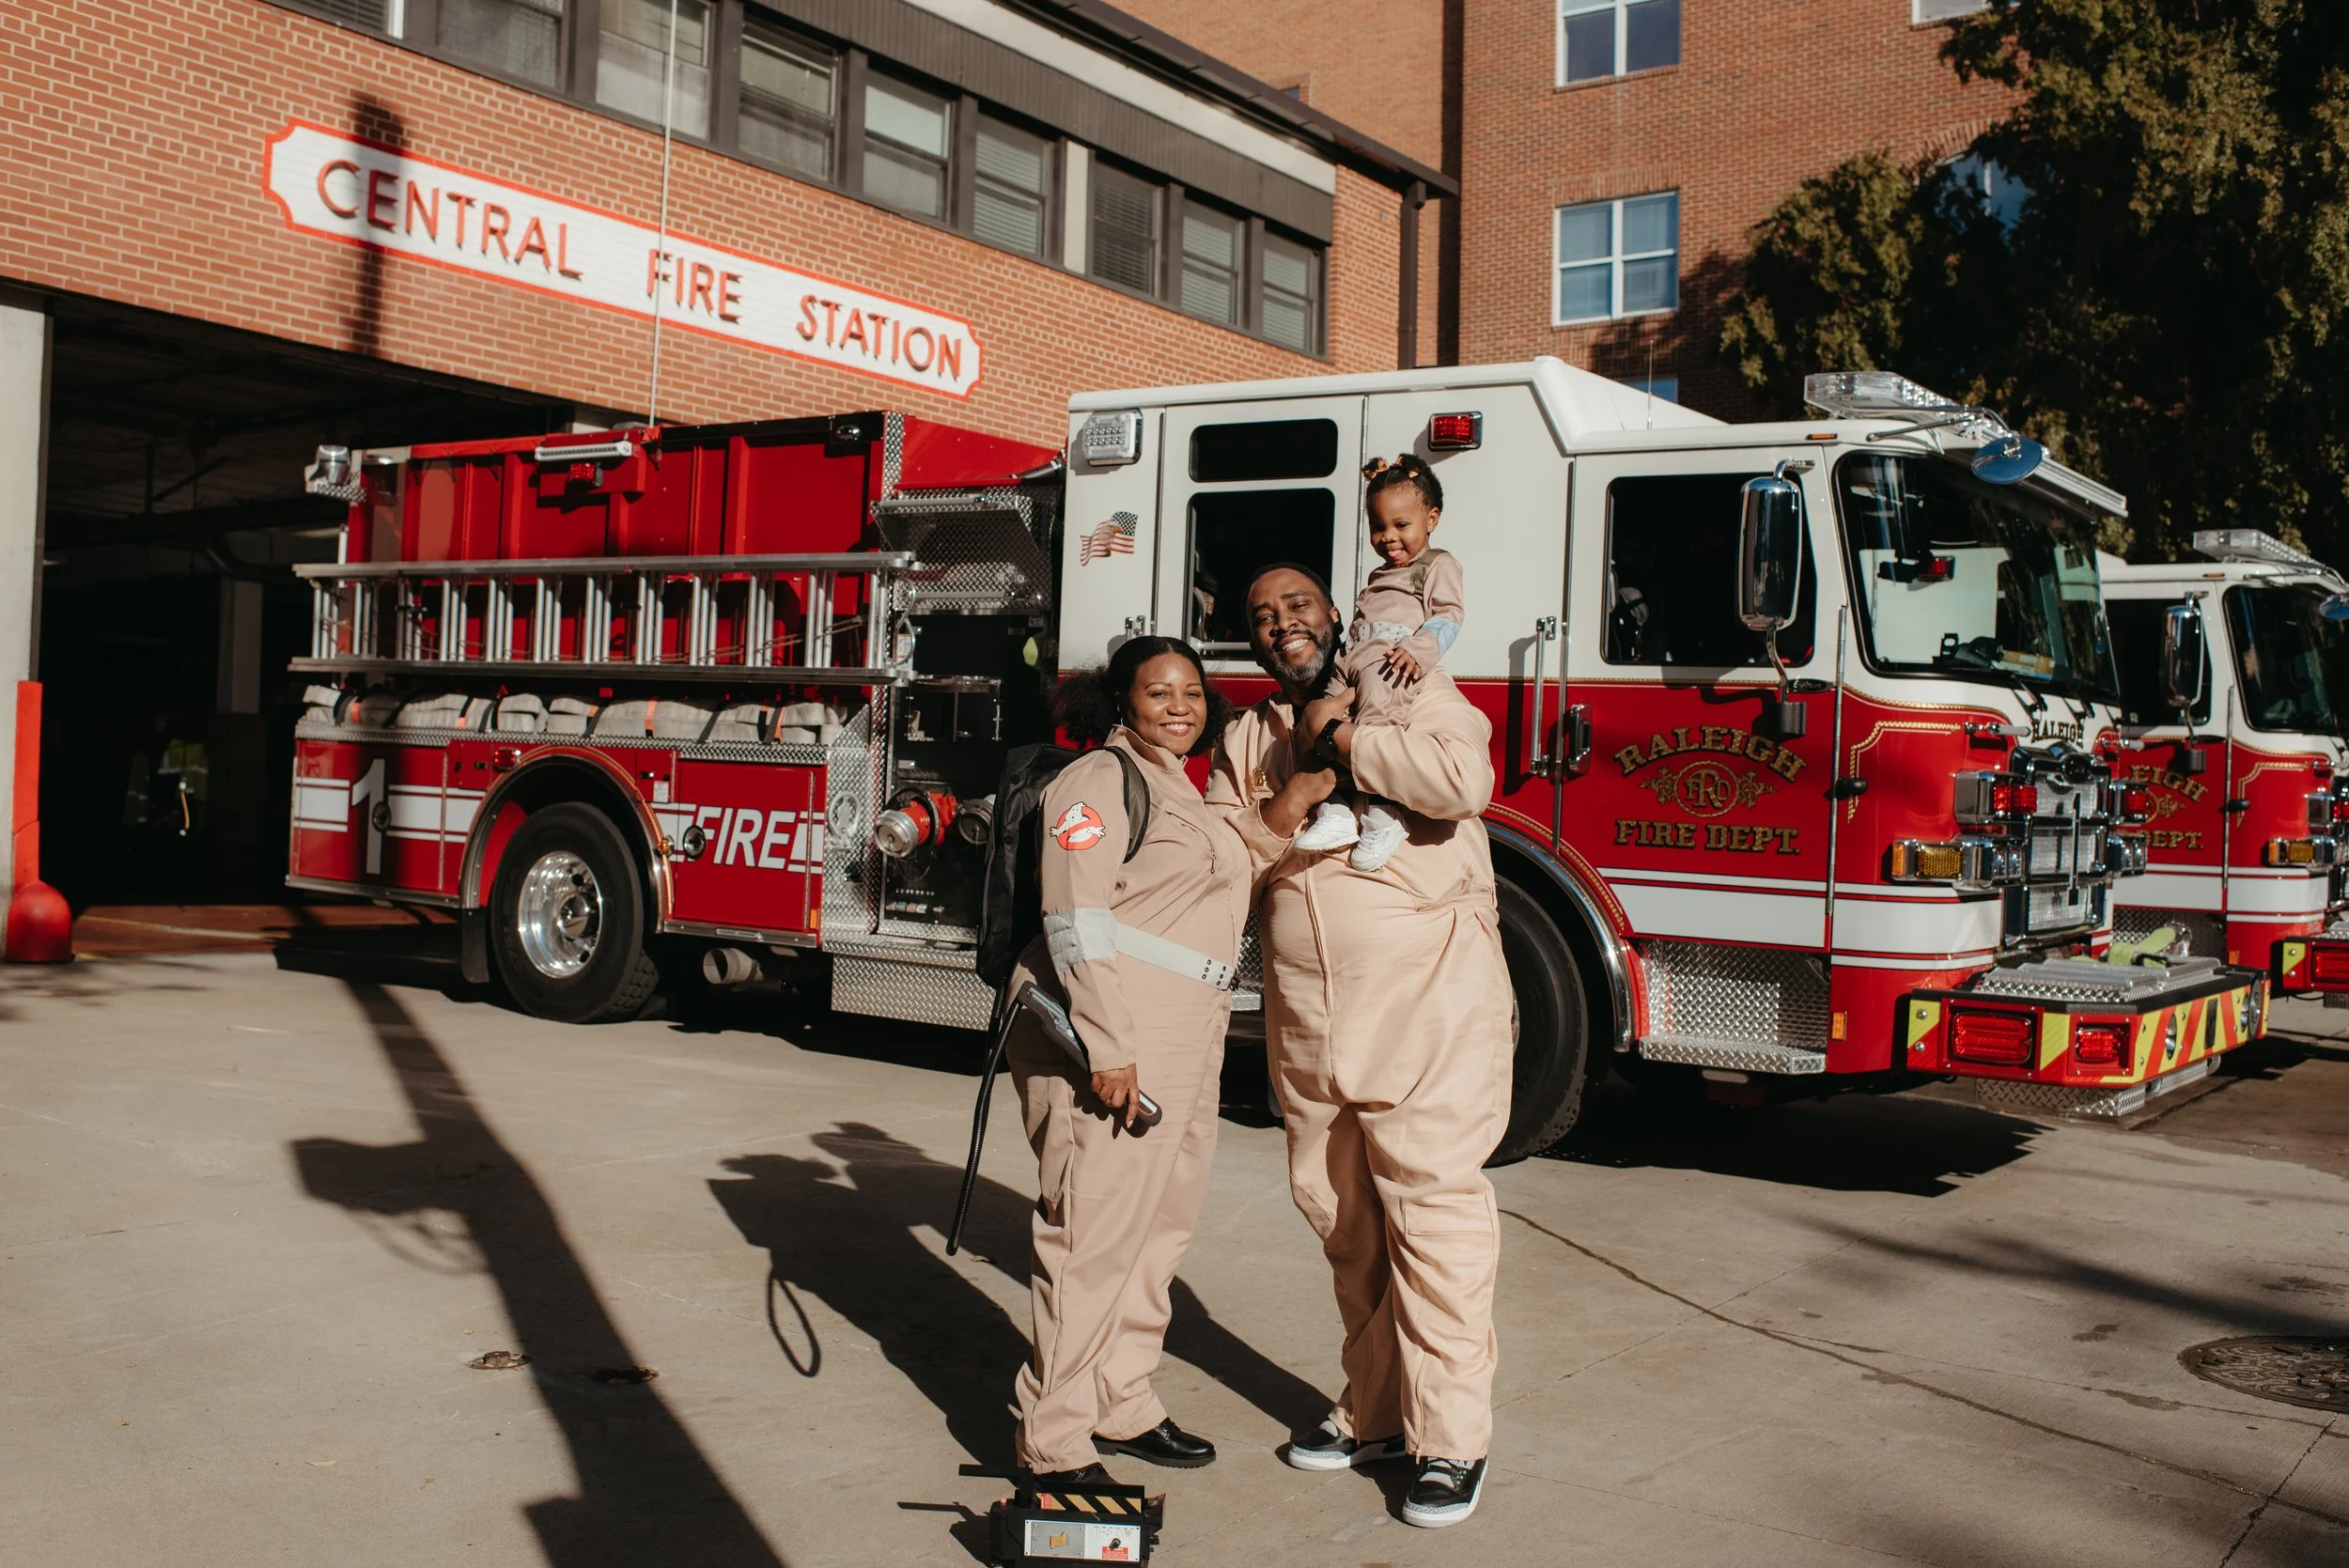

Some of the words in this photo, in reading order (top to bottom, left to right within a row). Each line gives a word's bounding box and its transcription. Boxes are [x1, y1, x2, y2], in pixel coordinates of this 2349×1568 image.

[317, 160, 583, 281] CENTRAL
[646, 248, 742, 323] FIRE
[796, 294, 961, 380] STATION
[1613, 725, 1807, 783] RALEIGH
[2116, 765, 2209, 802] EIGH
[351, 759, 385, 875] 1
[688, 806, 797, 869] FIRE
[1614, 819, 1697, 848] FIRE
[1704, 824, 1800, 854] DEPT.
[2145, 831, 2203, 850] EPT.
